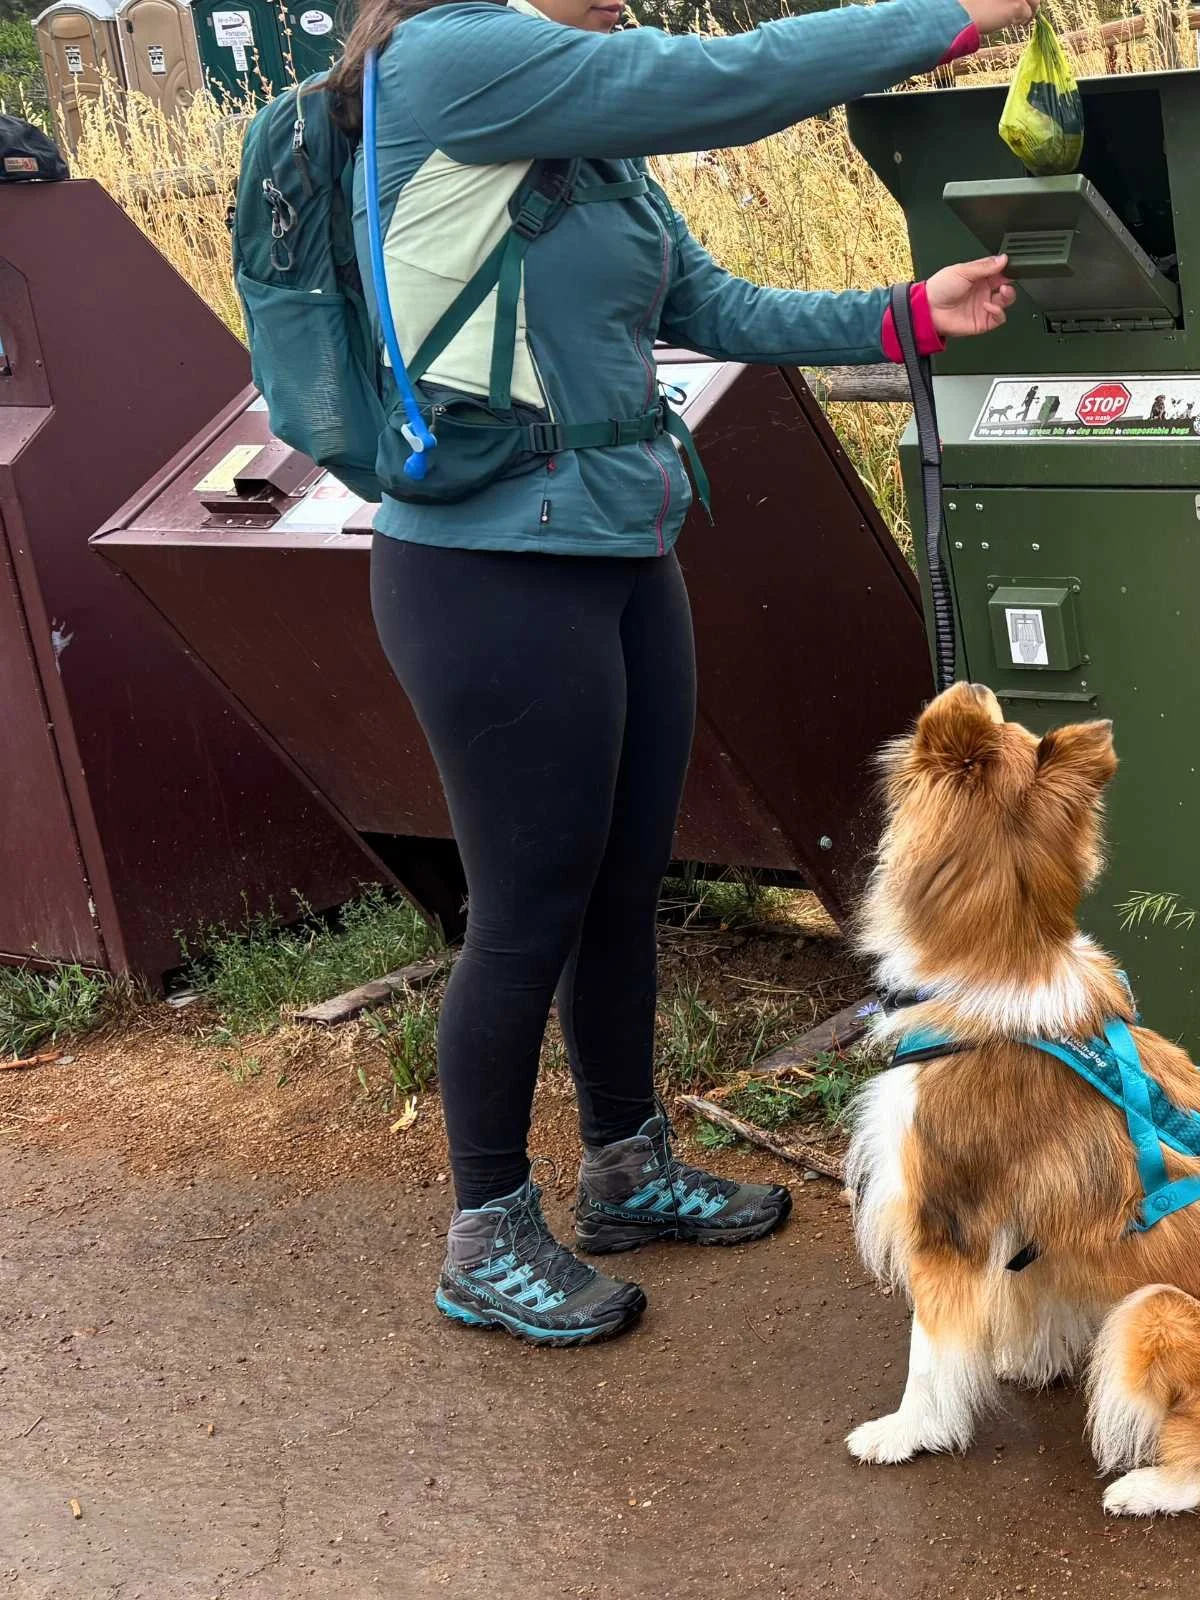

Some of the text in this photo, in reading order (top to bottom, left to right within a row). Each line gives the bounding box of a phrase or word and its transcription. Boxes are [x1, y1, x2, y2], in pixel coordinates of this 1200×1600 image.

[1080, 397, 1125, 413] STOP
[1029, 428, 1051, 437] green
[1066, 427, 1076, 435] for
[1076, 427, 1090, 436] dog
[1122, 427, 1169, 436] compostable
[1171, 427, 1190, 436] bags
